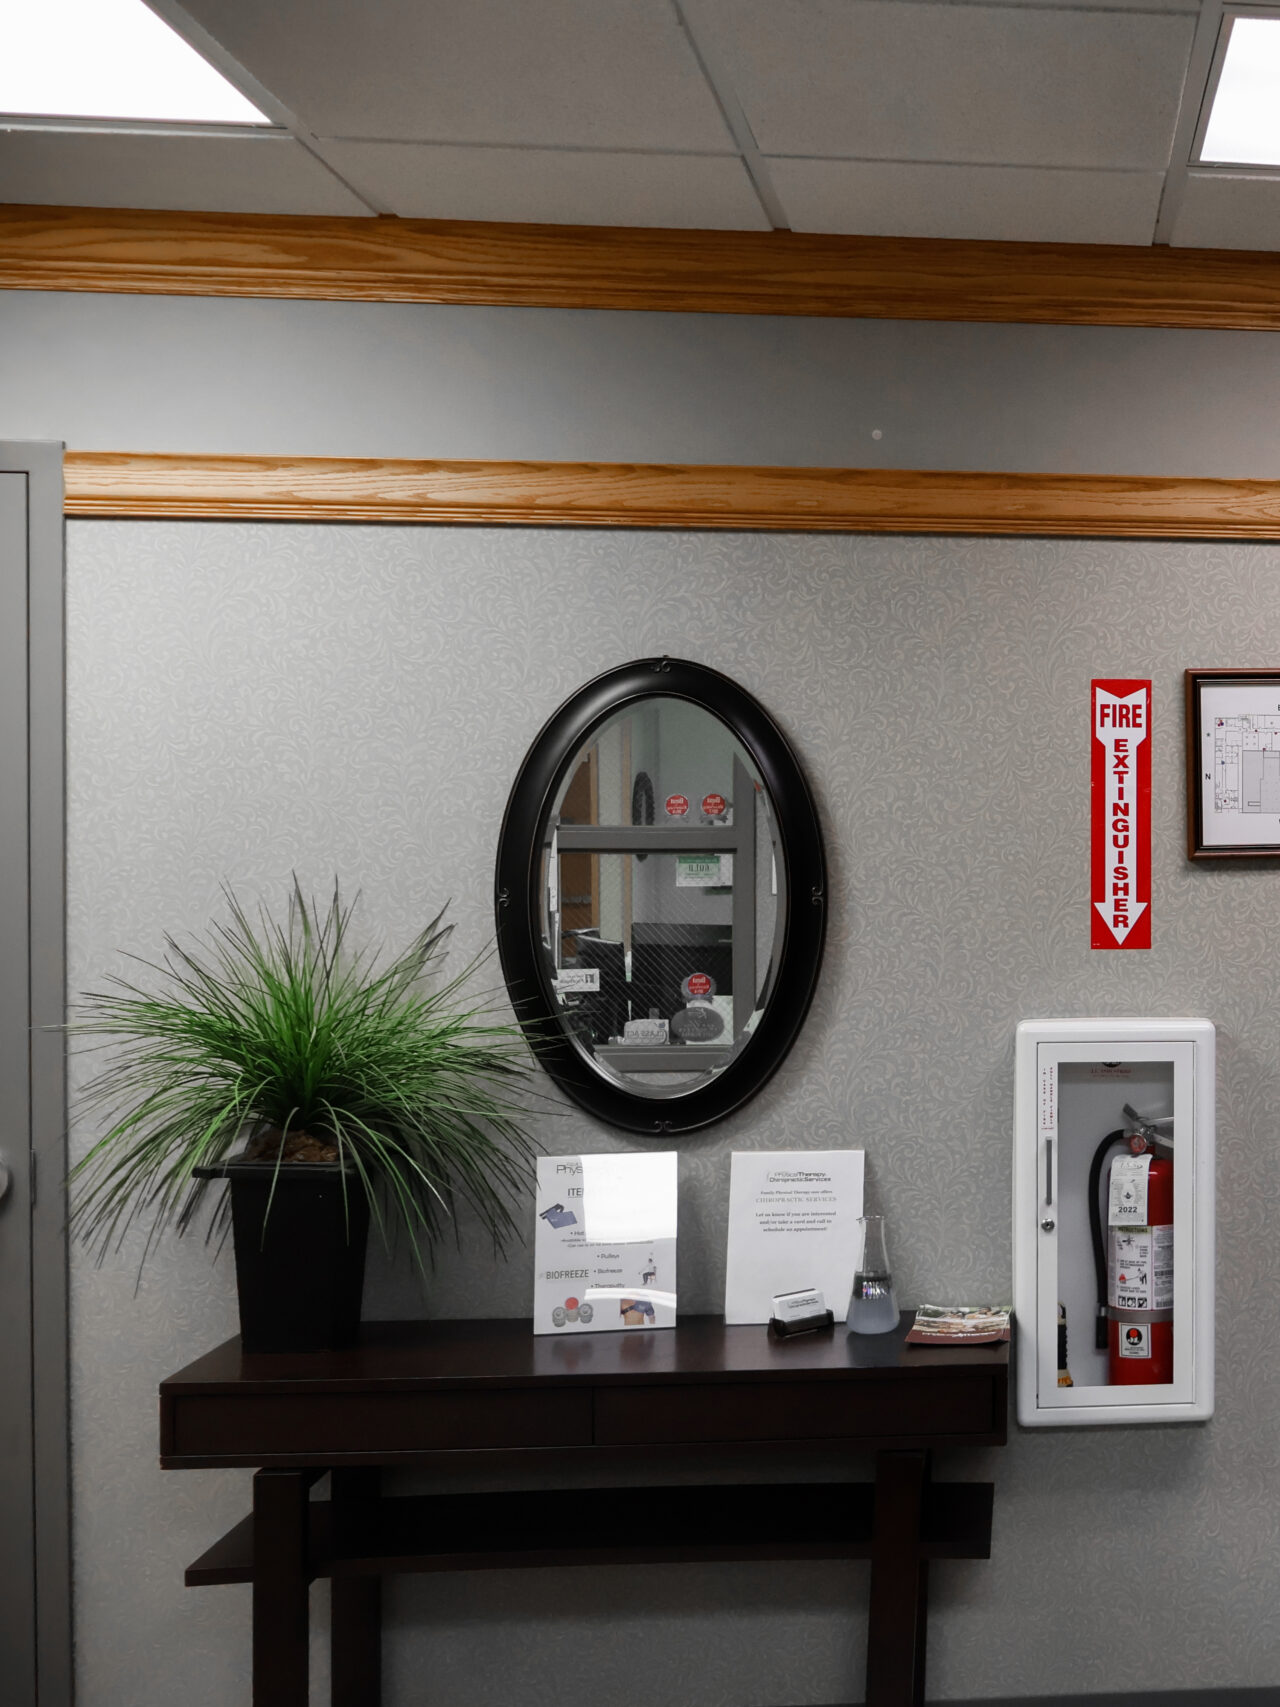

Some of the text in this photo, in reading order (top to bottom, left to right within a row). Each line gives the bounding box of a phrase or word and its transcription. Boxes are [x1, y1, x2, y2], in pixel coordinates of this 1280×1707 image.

[1100, 704, 1142, 728] FIRE
[1112, 738, 1130, 929] EXTINGUISHER
[556, 1164, 583, 1176] Phys
[546, 1269, 589, 1280] BIOFREEZE
